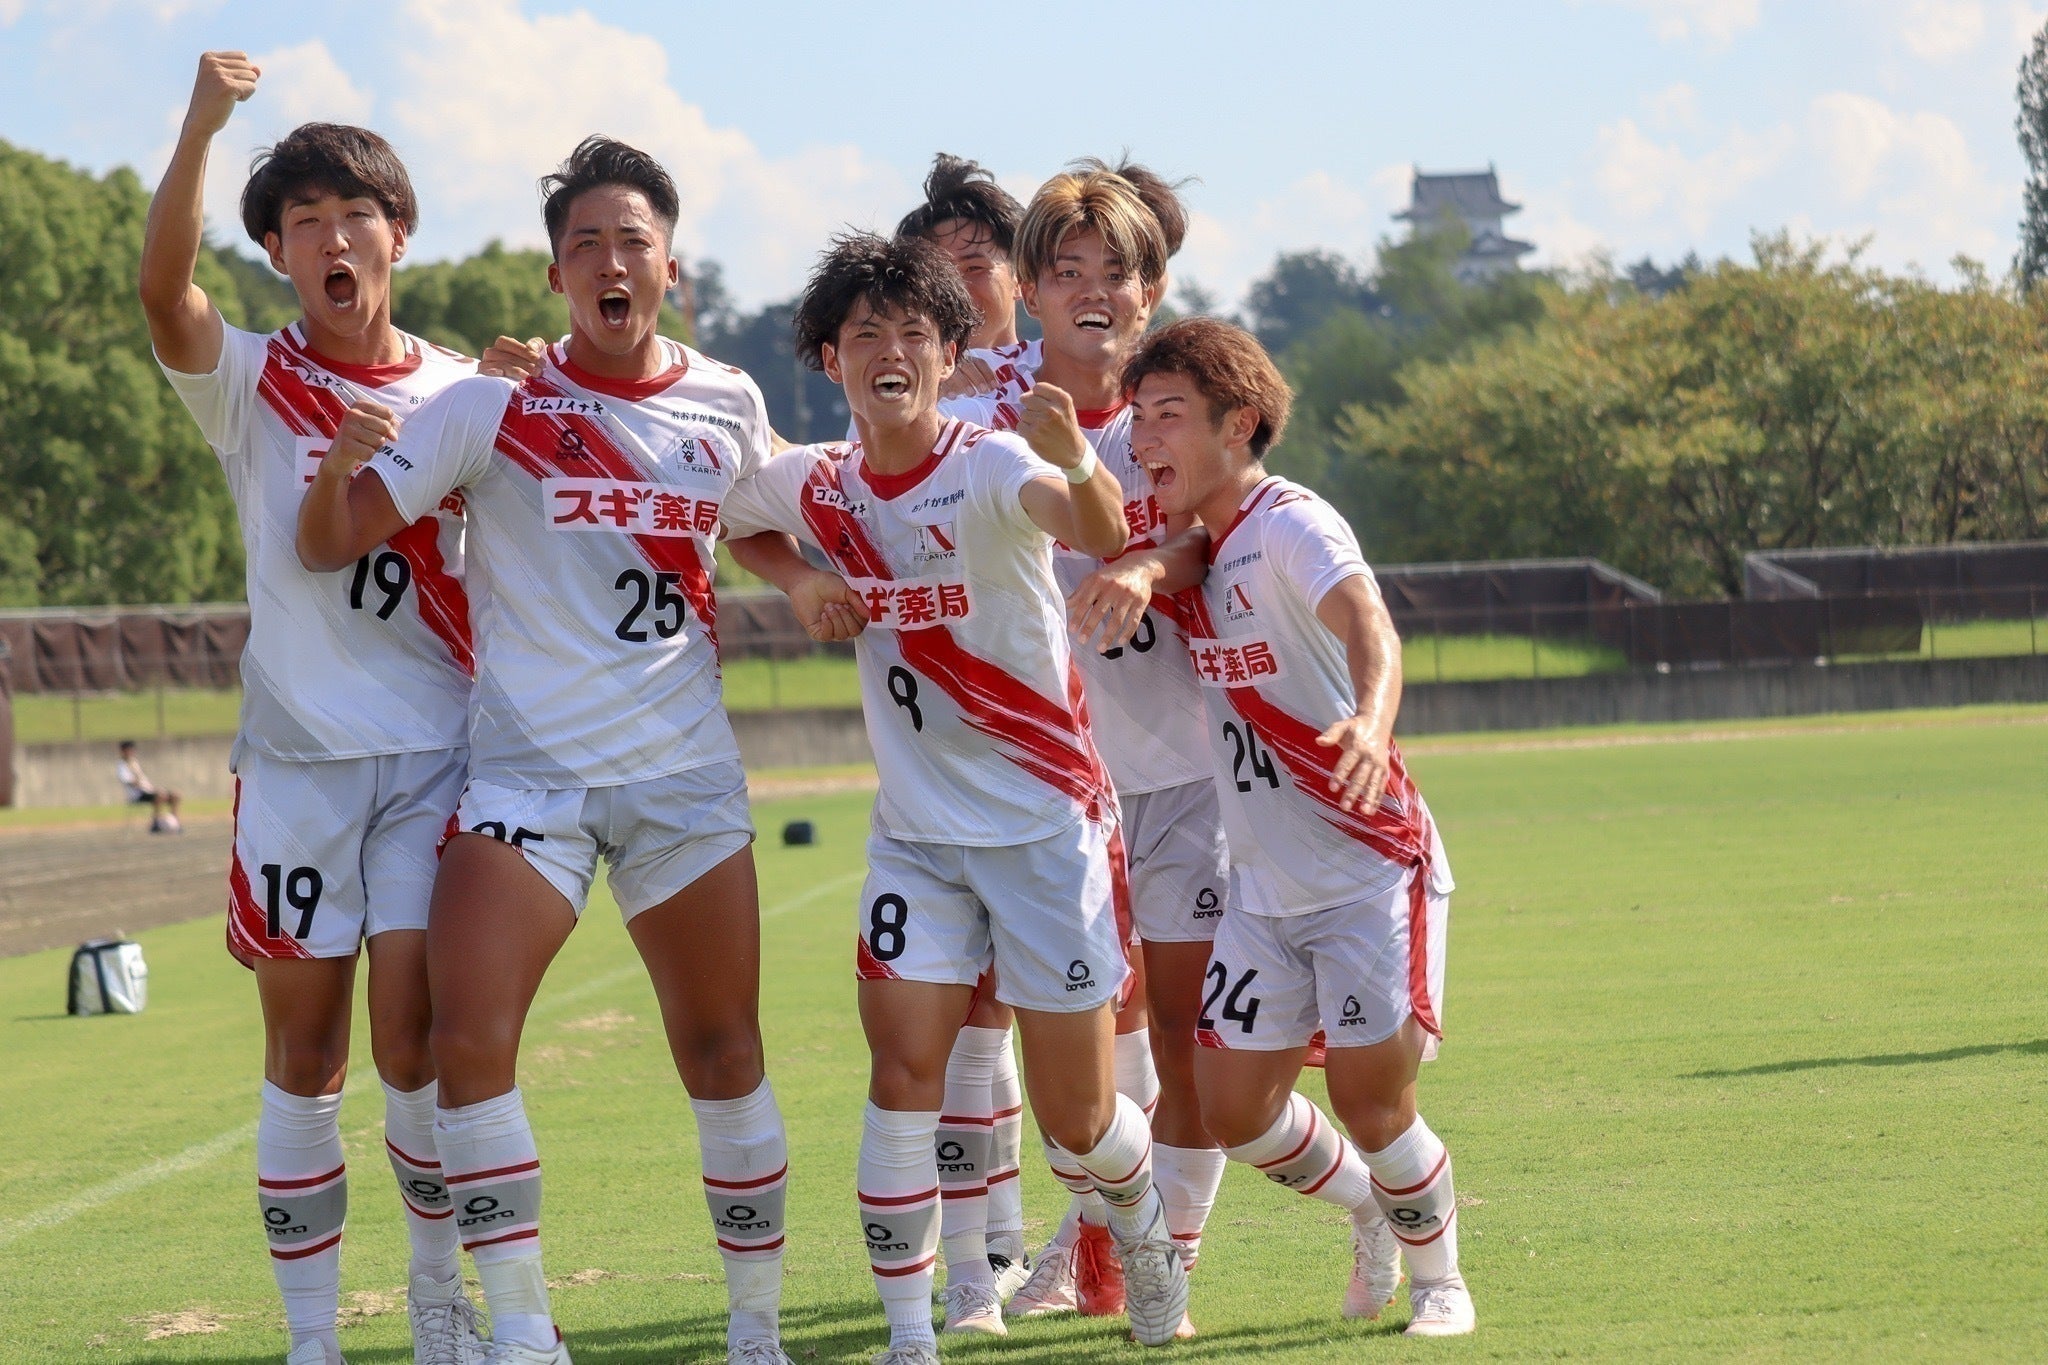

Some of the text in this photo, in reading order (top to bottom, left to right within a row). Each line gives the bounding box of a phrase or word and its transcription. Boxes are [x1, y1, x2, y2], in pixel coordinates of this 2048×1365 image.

[525, 399, 604, 414] ゴムノイナキ
[671, 410, 741, 431] おおすが整形外科
[392, 454, 414, 471] CITY
[691, 466, 721, 477] KARIYA
[554, 487, 720, 536] スギ薬局
[350, 551, 411, 621] 19
[614, 568, 686, 643] 25
[854, 583, 970, 626] ギ薬局
[1222, 720, 1280, 793] 24
[261, 864, 324, 939] 19
[870, 893, 908, 961] 8
[1198, 961, 1261, 1034] 24
